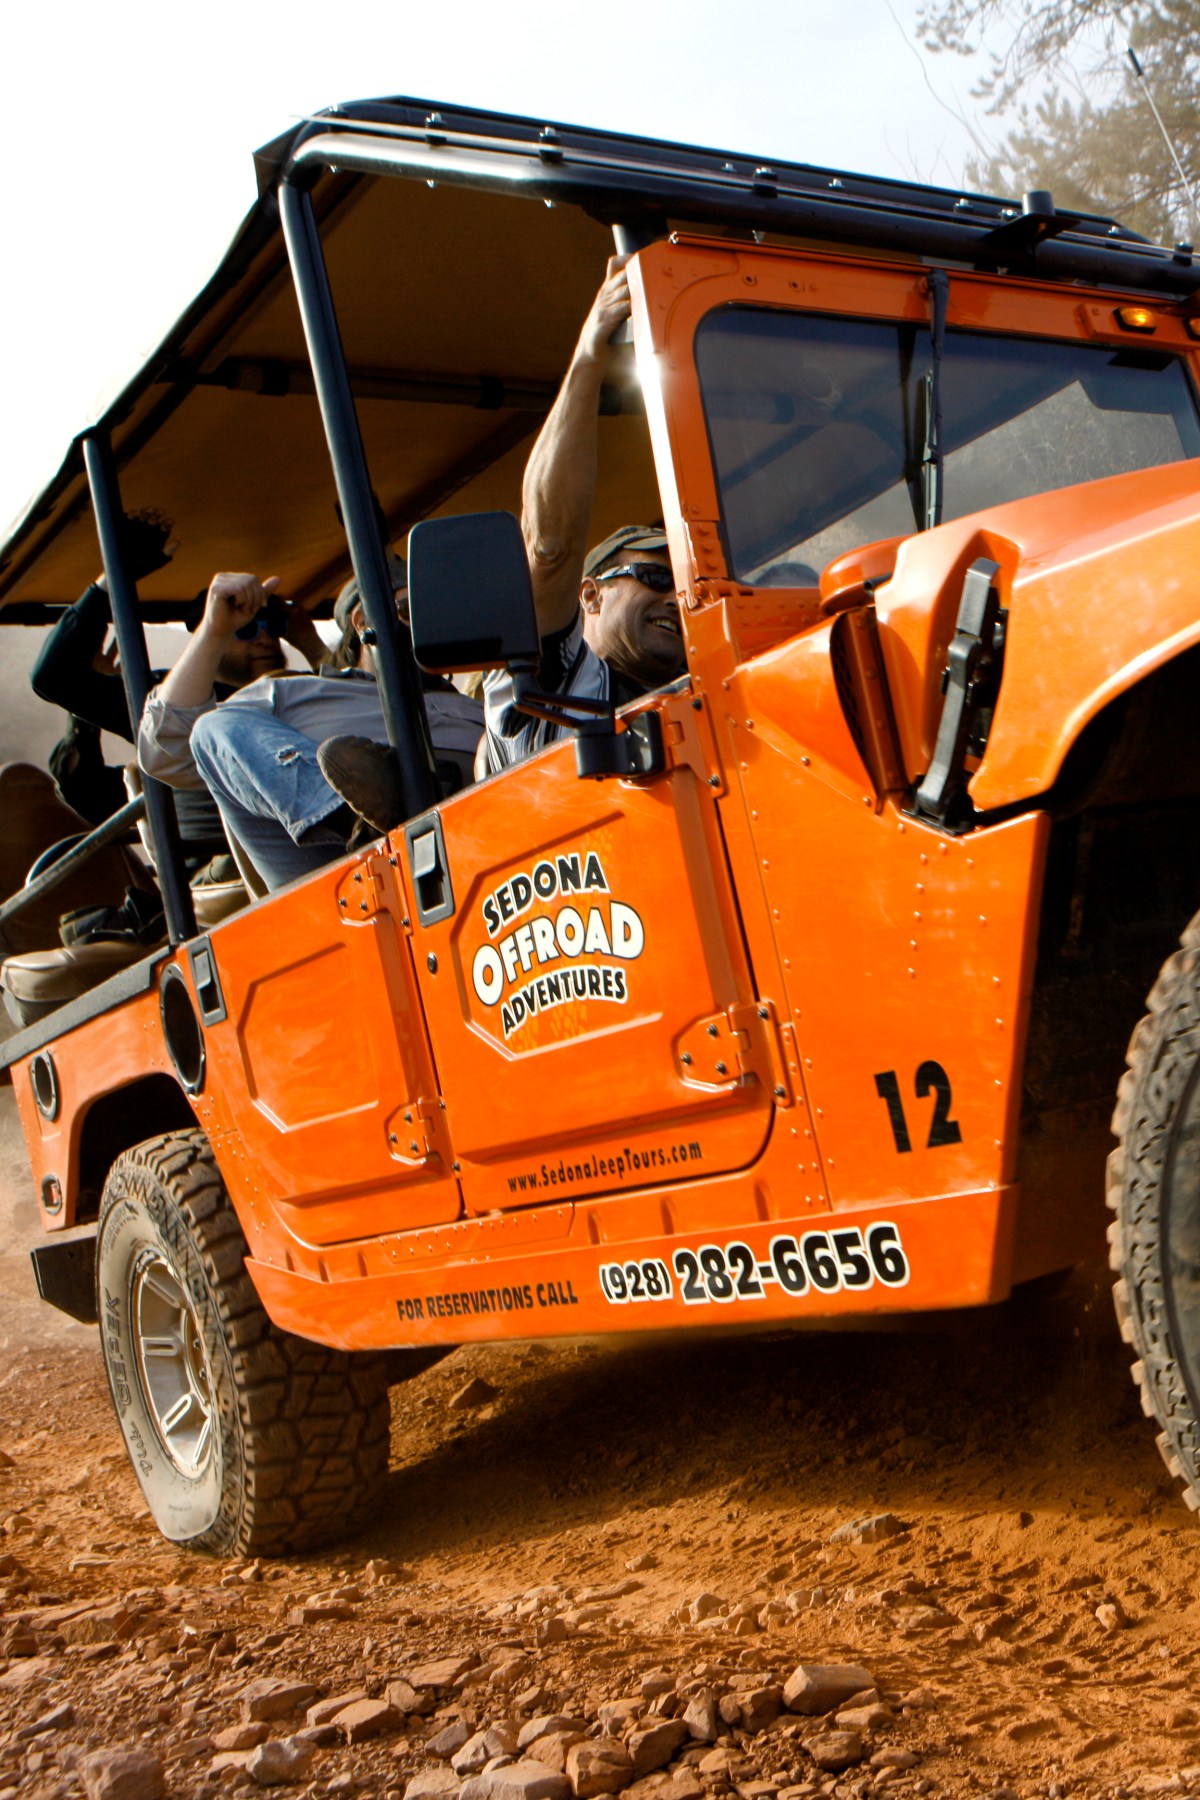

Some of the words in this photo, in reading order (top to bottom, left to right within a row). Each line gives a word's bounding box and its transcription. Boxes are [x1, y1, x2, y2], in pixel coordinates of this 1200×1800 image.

[483, 852, 609, 937] SEDONA
[472, 900, 645, 1007] OFFROAD
[501, 966, 628, 1039] ADVENTURES
[873, 1059, 962, 1155] 12
[507, 1138, 702, 1193] www.SedonaJeepTours.com
[396, 1297, 424, 1322] FOR
[427, 1285, 534, 1319] RESERVATIONS
[536, 1280, 578, 1307] CALL
[600, 1259, 673, 1304] (928)
[673, 1221, 910, 1305] 282-6656
